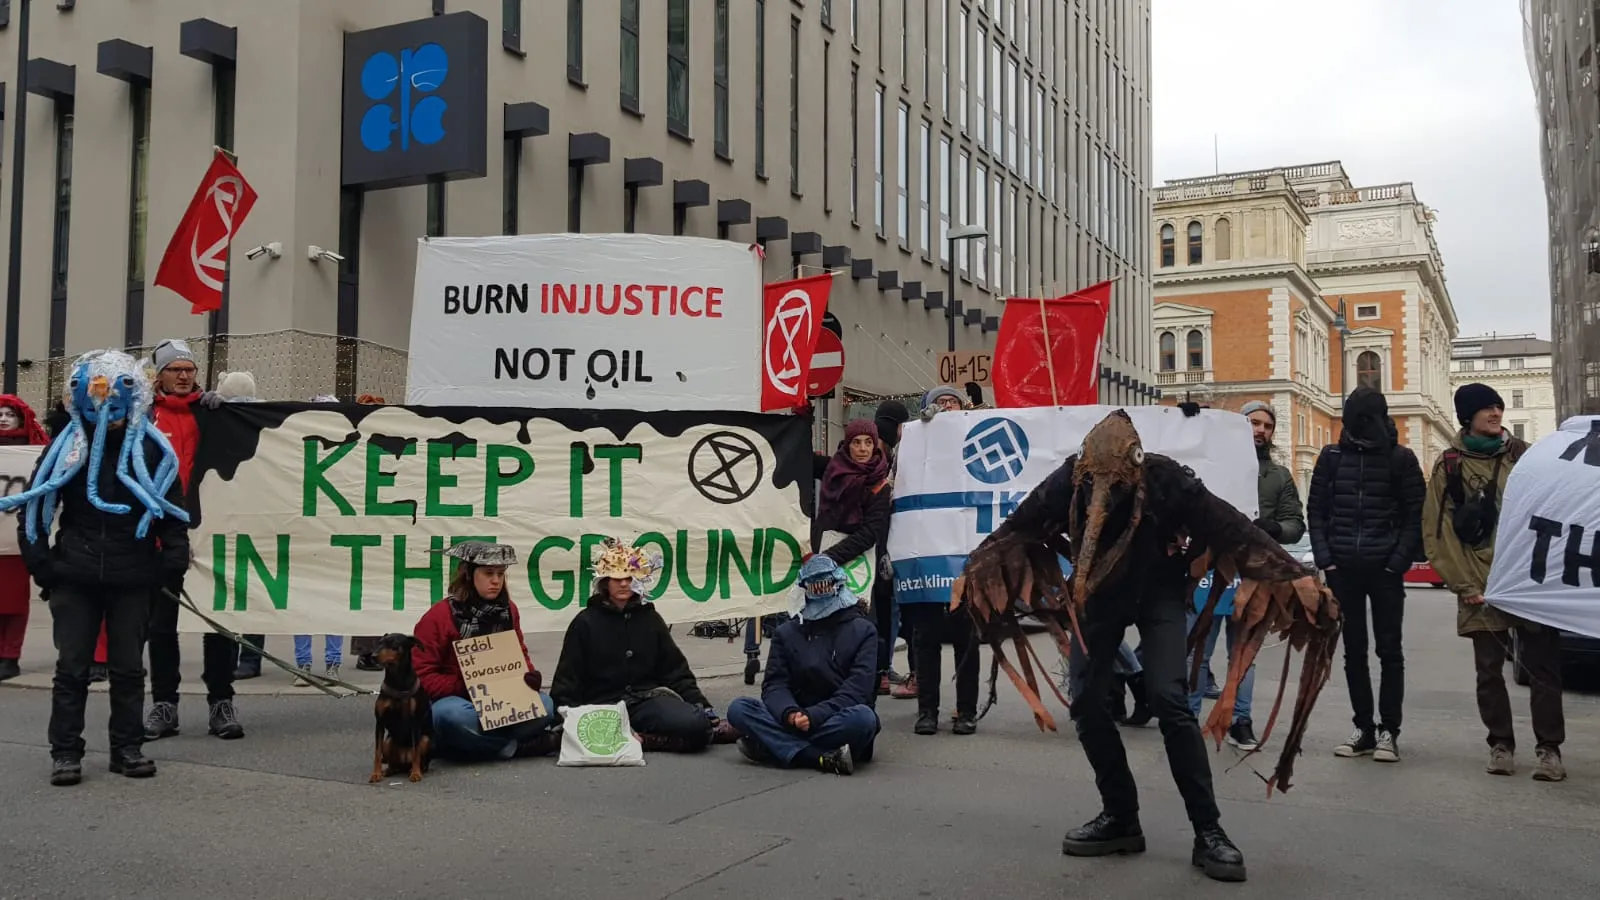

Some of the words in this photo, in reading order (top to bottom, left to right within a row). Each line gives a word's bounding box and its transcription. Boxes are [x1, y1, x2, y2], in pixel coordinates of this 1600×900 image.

[444, 284, 528, 315] BURN
[541, 284, 723, 318] INJUSTICE
[495, 348, 575, 381] NOT
[587, 349, 652, 382] OIL
[941, 355, 956, 383] Oil
[303, 435, 535, 519] KEEP
[570, 441, 642, 517] IT
[211, 534, 291, 611] IN
[924, 573, 959, 589] klim
[455, 636, 494, 655] Erdöl
[461, 655, 476, 667] ist
